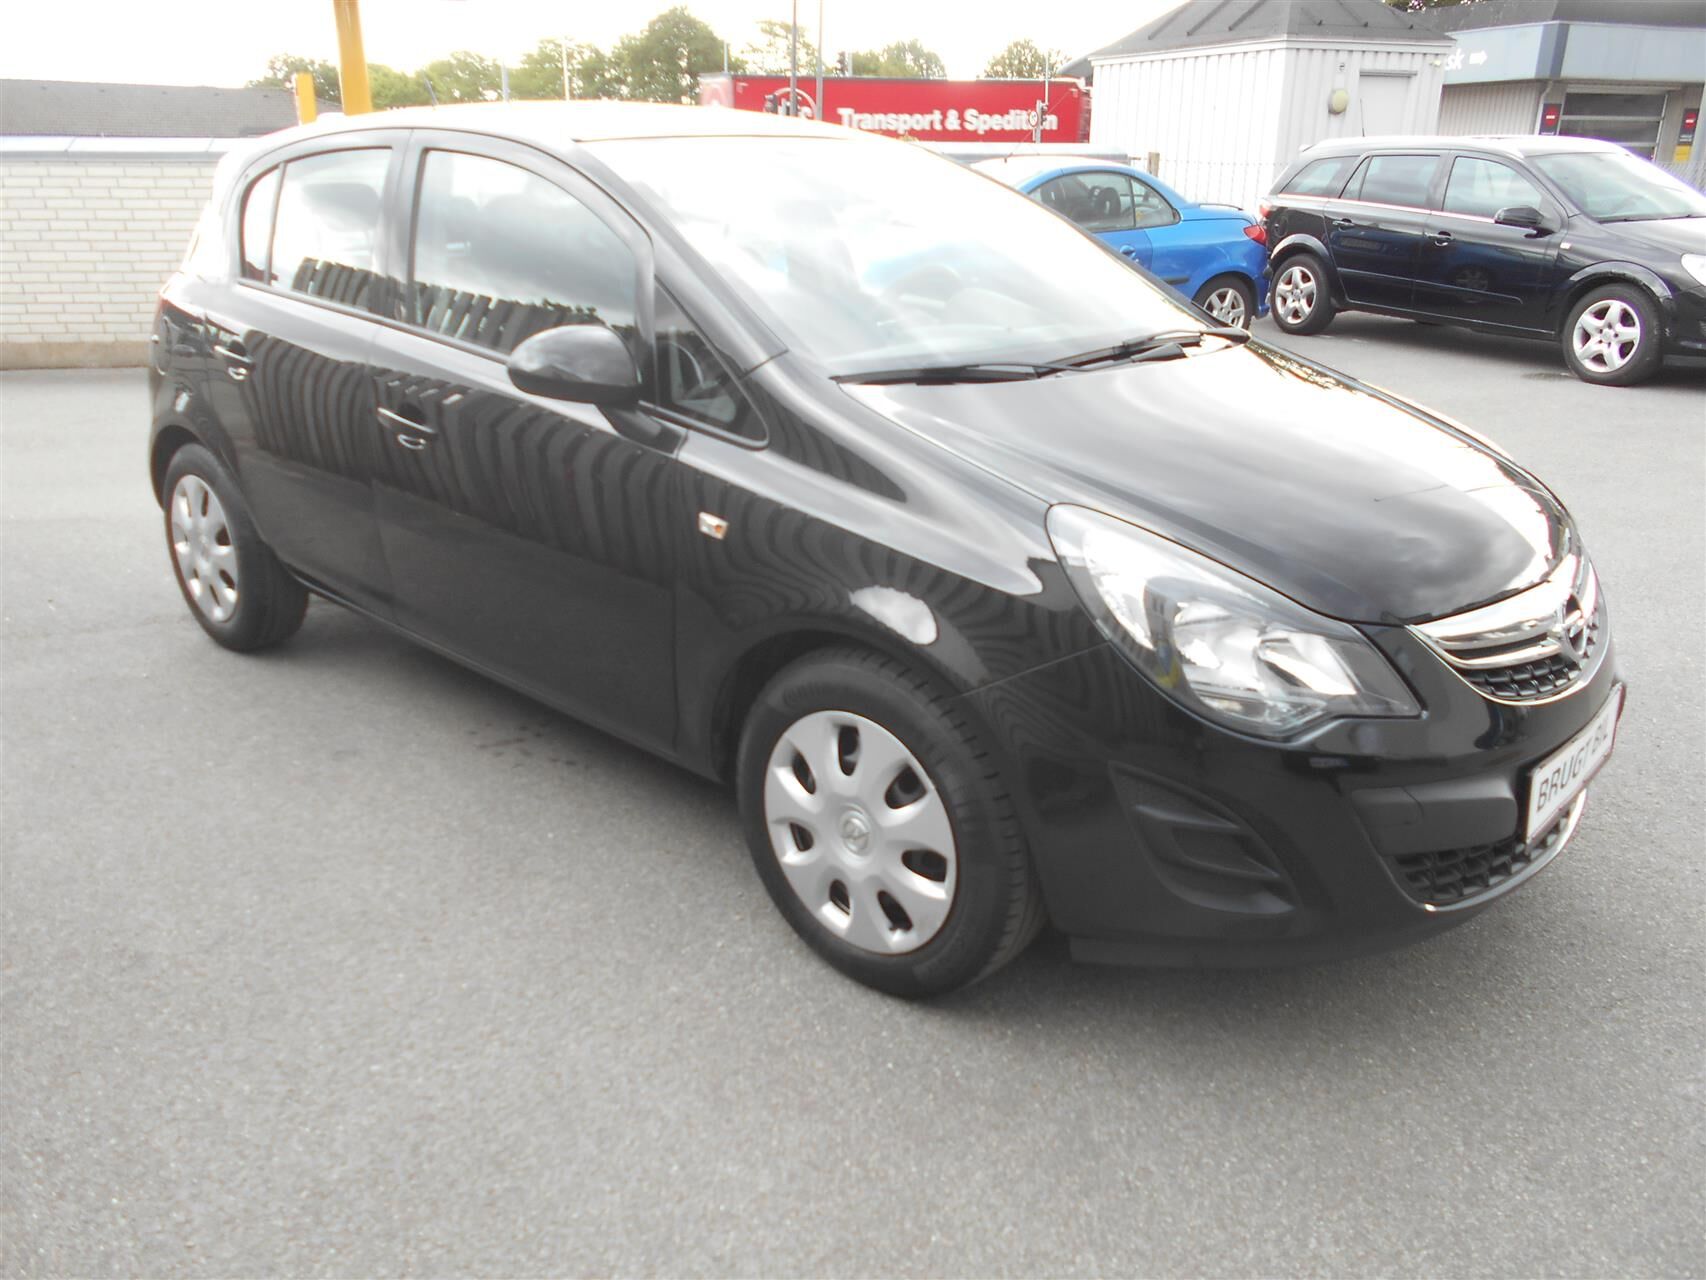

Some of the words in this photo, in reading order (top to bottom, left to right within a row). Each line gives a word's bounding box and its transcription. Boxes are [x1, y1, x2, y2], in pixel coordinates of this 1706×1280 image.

[836, 107, 943, 135] Transport
[944, 108, 962, 131] &
[963, 108, 1059, 135] Speditn
